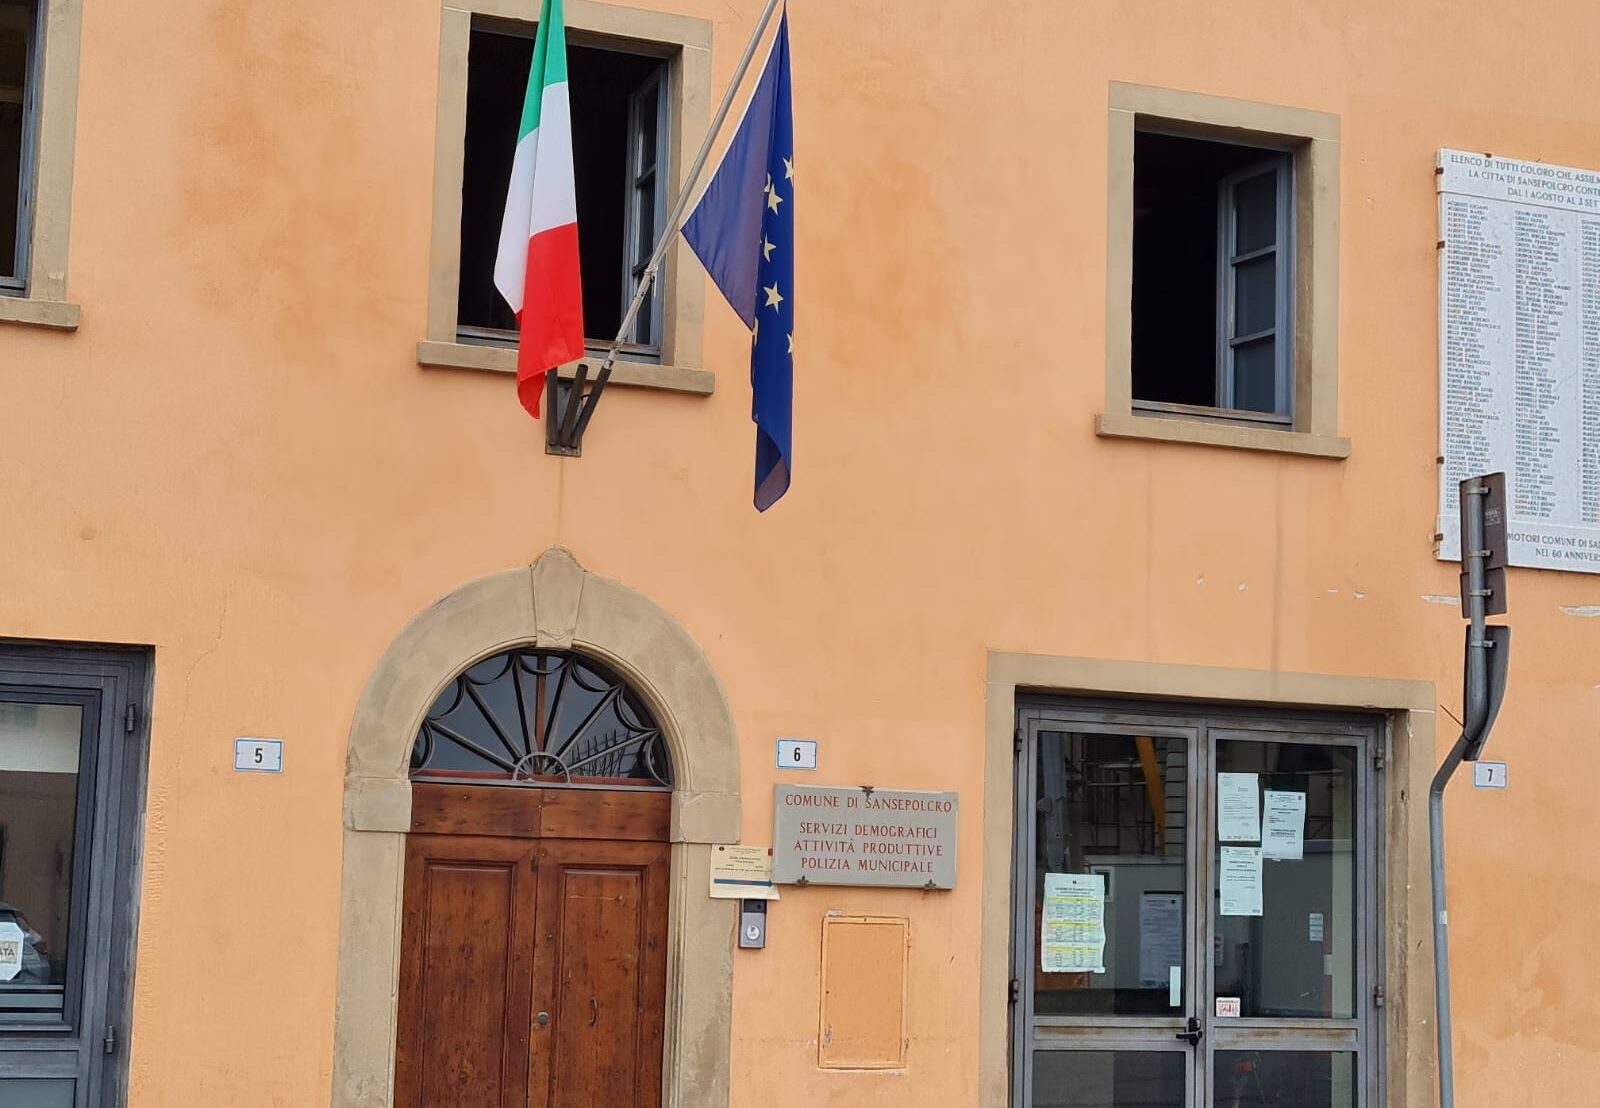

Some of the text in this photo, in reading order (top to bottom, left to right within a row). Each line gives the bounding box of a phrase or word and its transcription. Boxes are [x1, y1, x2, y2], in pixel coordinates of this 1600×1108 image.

[1450, 155, 1482, 167] ELENCO
[1484, 159, 1493, 169] DI
[1495, 160, 1519, 173] TUTTI
[1520, 164, 1555, 178] COLORO
[1556, 170, 1574, 180] CHE
[1468, 169, 1479, 178] LA
[1507, 175, 1516, 185] DI
[1517, 176, 1574, 192] SANSEPOLCRO
[1507, 187, 1524, 197] DAL
[1531, 192, 1565, 204] AGOSTO
[1566, 196, 1577, 205] AL
[1541, 535, 1576, 547] COMUNE
[1578, 538, 1587, 549] DI
[1535, 547, 1550, 558] NEL
[1552, 549, 1563, 559] 60
[254, 747, 264, 764] 5
[793, 746, 802, 762] 6
[1487, 768, 1493, 782] 7
[785, 794, 952, 813] COMUNE DI SANSEPOLCRO
[799, 822, 937, 839] SERVIZI DEMOGRAFICI
[863, 842, 943, 857] PRODUTTIVE
[801, 857, 934, 873] POLIZIA MUNICIPALE
